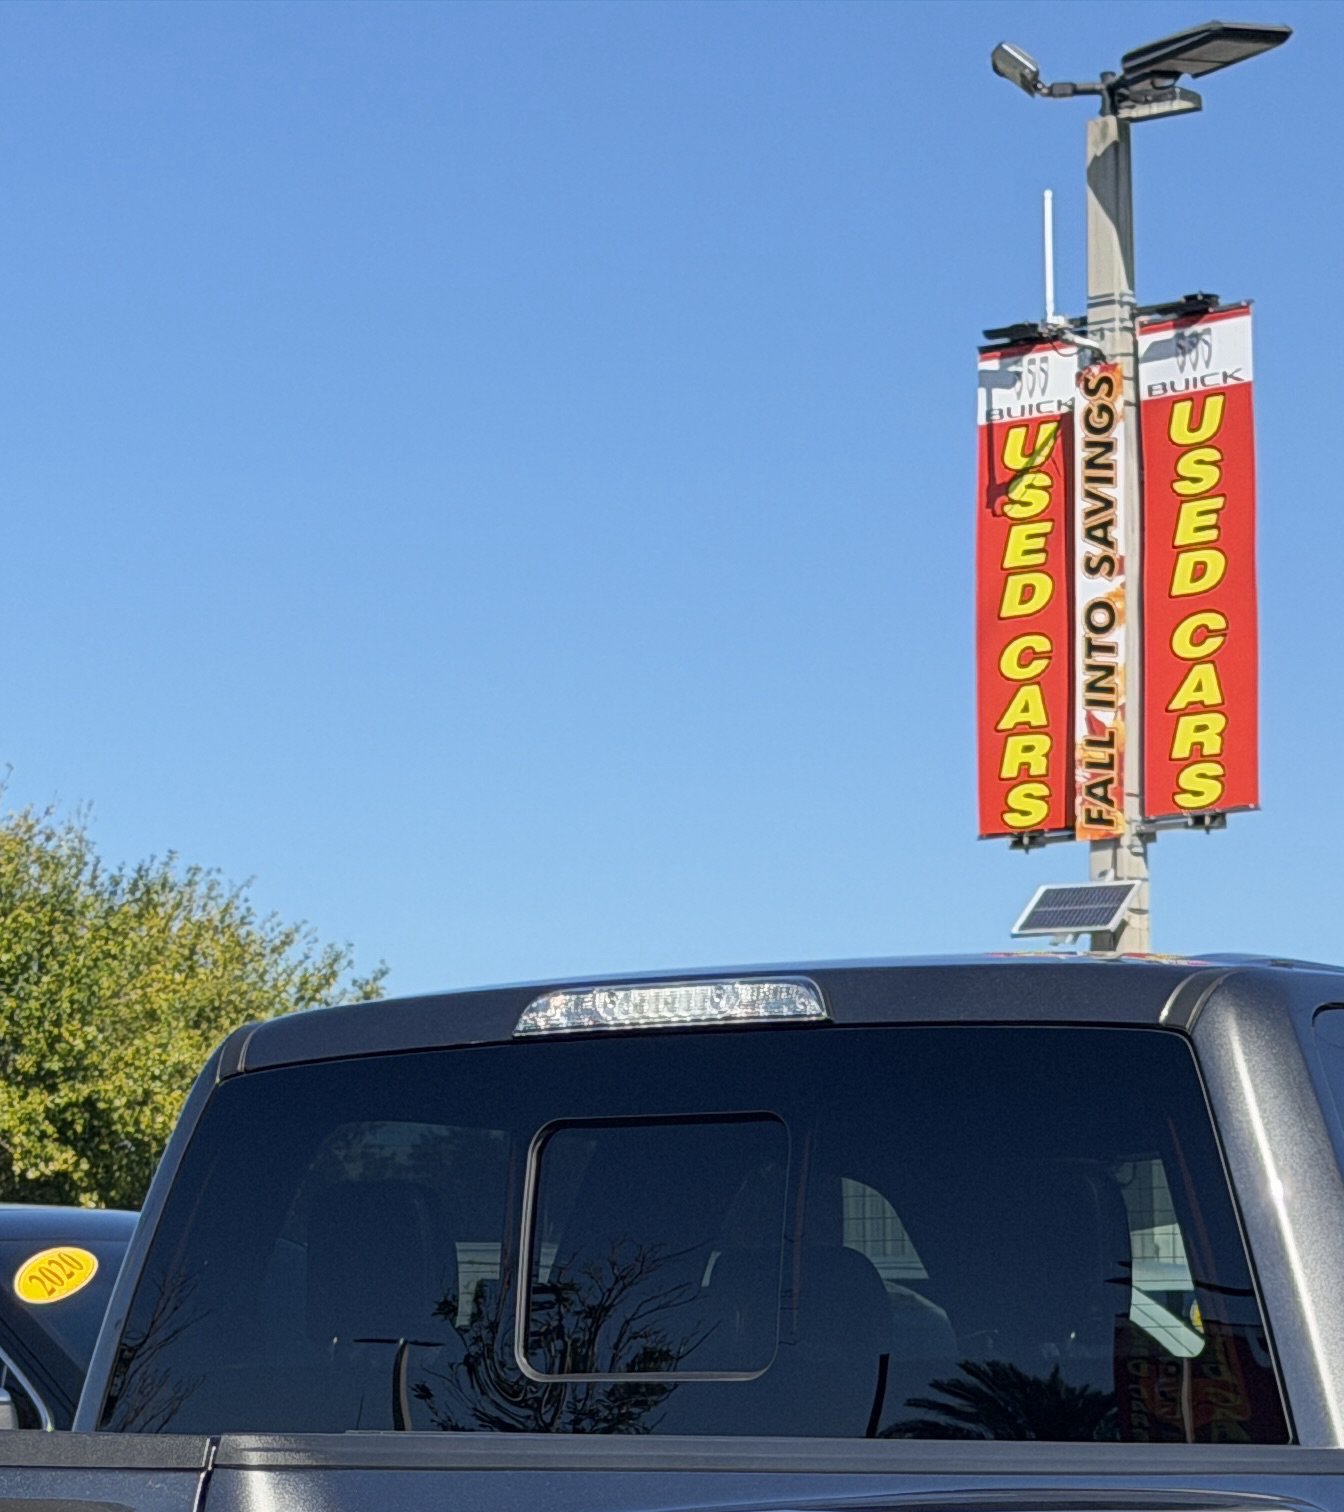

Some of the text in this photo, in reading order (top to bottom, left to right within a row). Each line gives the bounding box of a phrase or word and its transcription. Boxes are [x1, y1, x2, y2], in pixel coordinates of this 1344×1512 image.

[986, 395, 1075, 422] BUICK
[1147, 368, 1244, 398] BUICK
[995, 419, 1061, 829] USED CARS
[1082, 372, 1120, 829] FALL INTO SAVINGS
[1166, 392, 1229, 811] USED CARS
[28, 1252, 84, 1297] 2020
